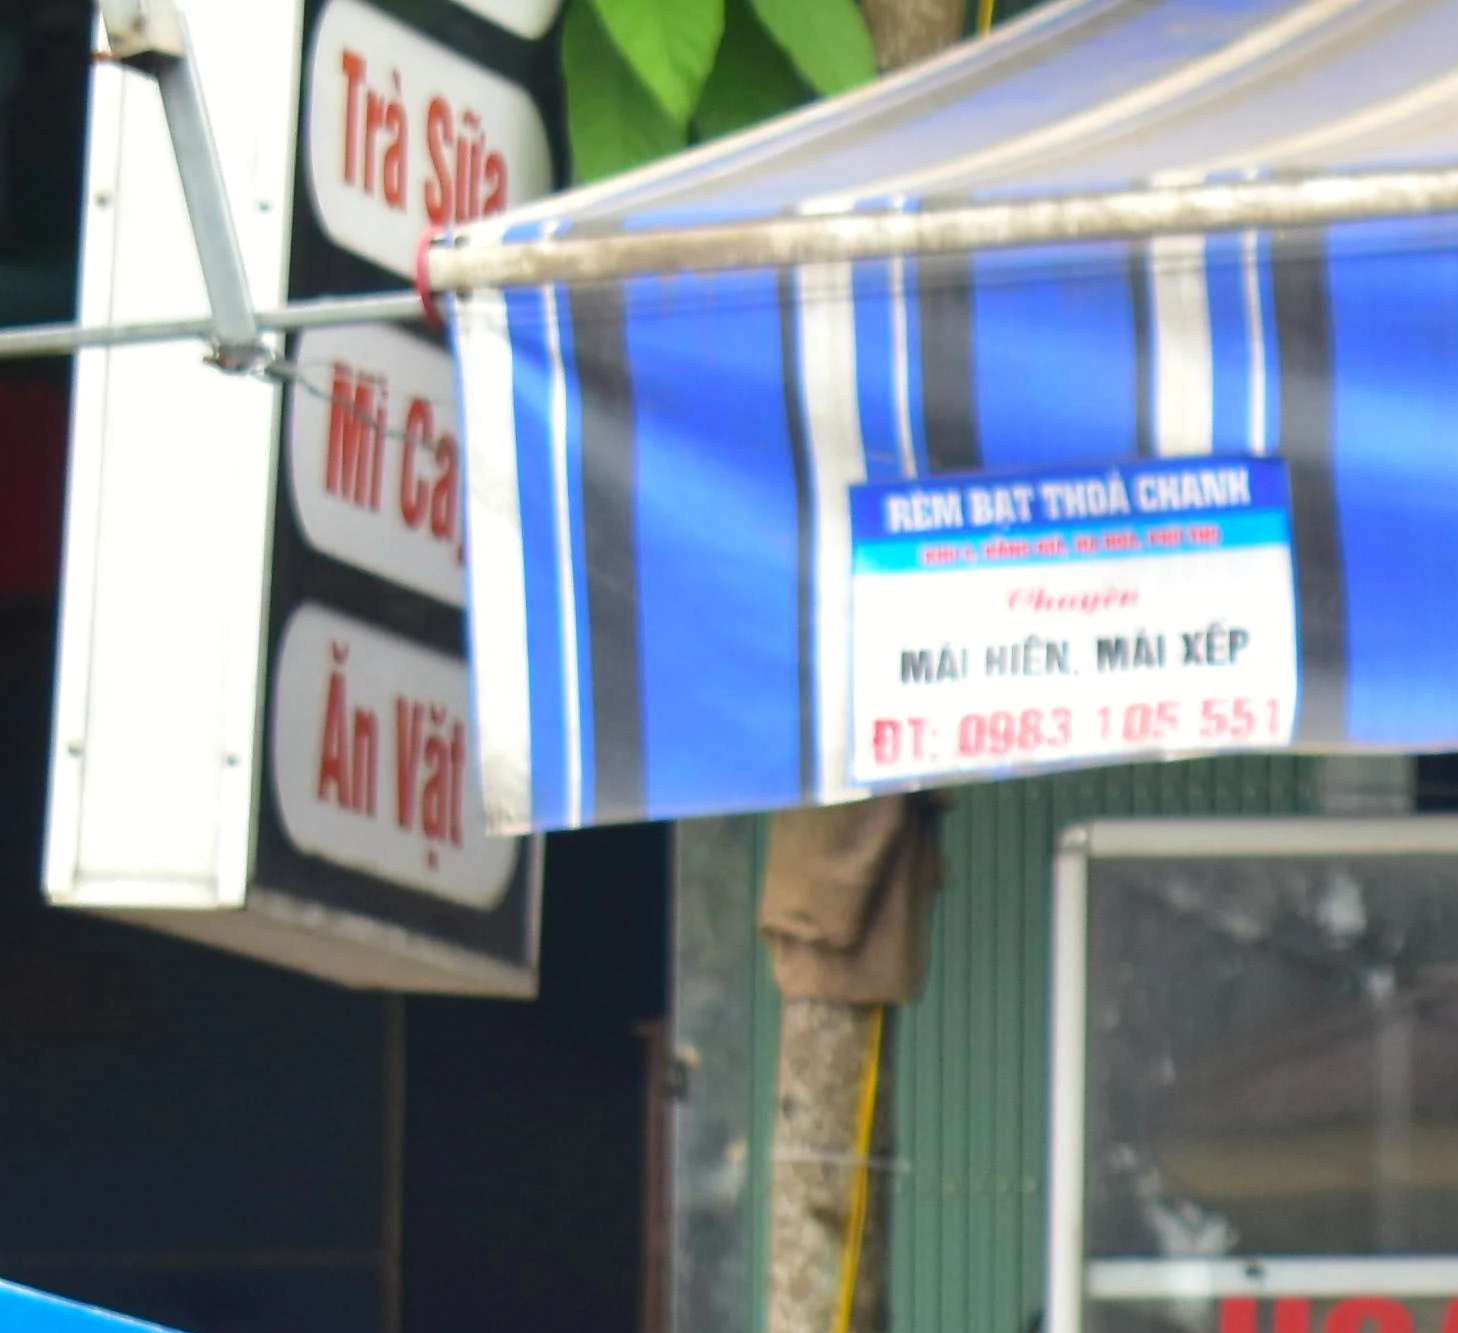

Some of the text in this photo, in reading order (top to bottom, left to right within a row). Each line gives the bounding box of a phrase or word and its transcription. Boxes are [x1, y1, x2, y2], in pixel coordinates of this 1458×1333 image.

[341, 47, 508, 228] Trà Sữa
[400, 396, 467, 567] Ca
[969, 485, 1034, 530] BẠT
[1136, 466, 1251, 512] CHANH
[900, 641, 967, 684] MÁI
[1096, 627, 1165, 672] MÁI
[1182, 617, 1250, 666] XẾP
[317, 638, 379, 820] Ăn
[873, 698, 1280, 765] ĐT: 0983 105 551
